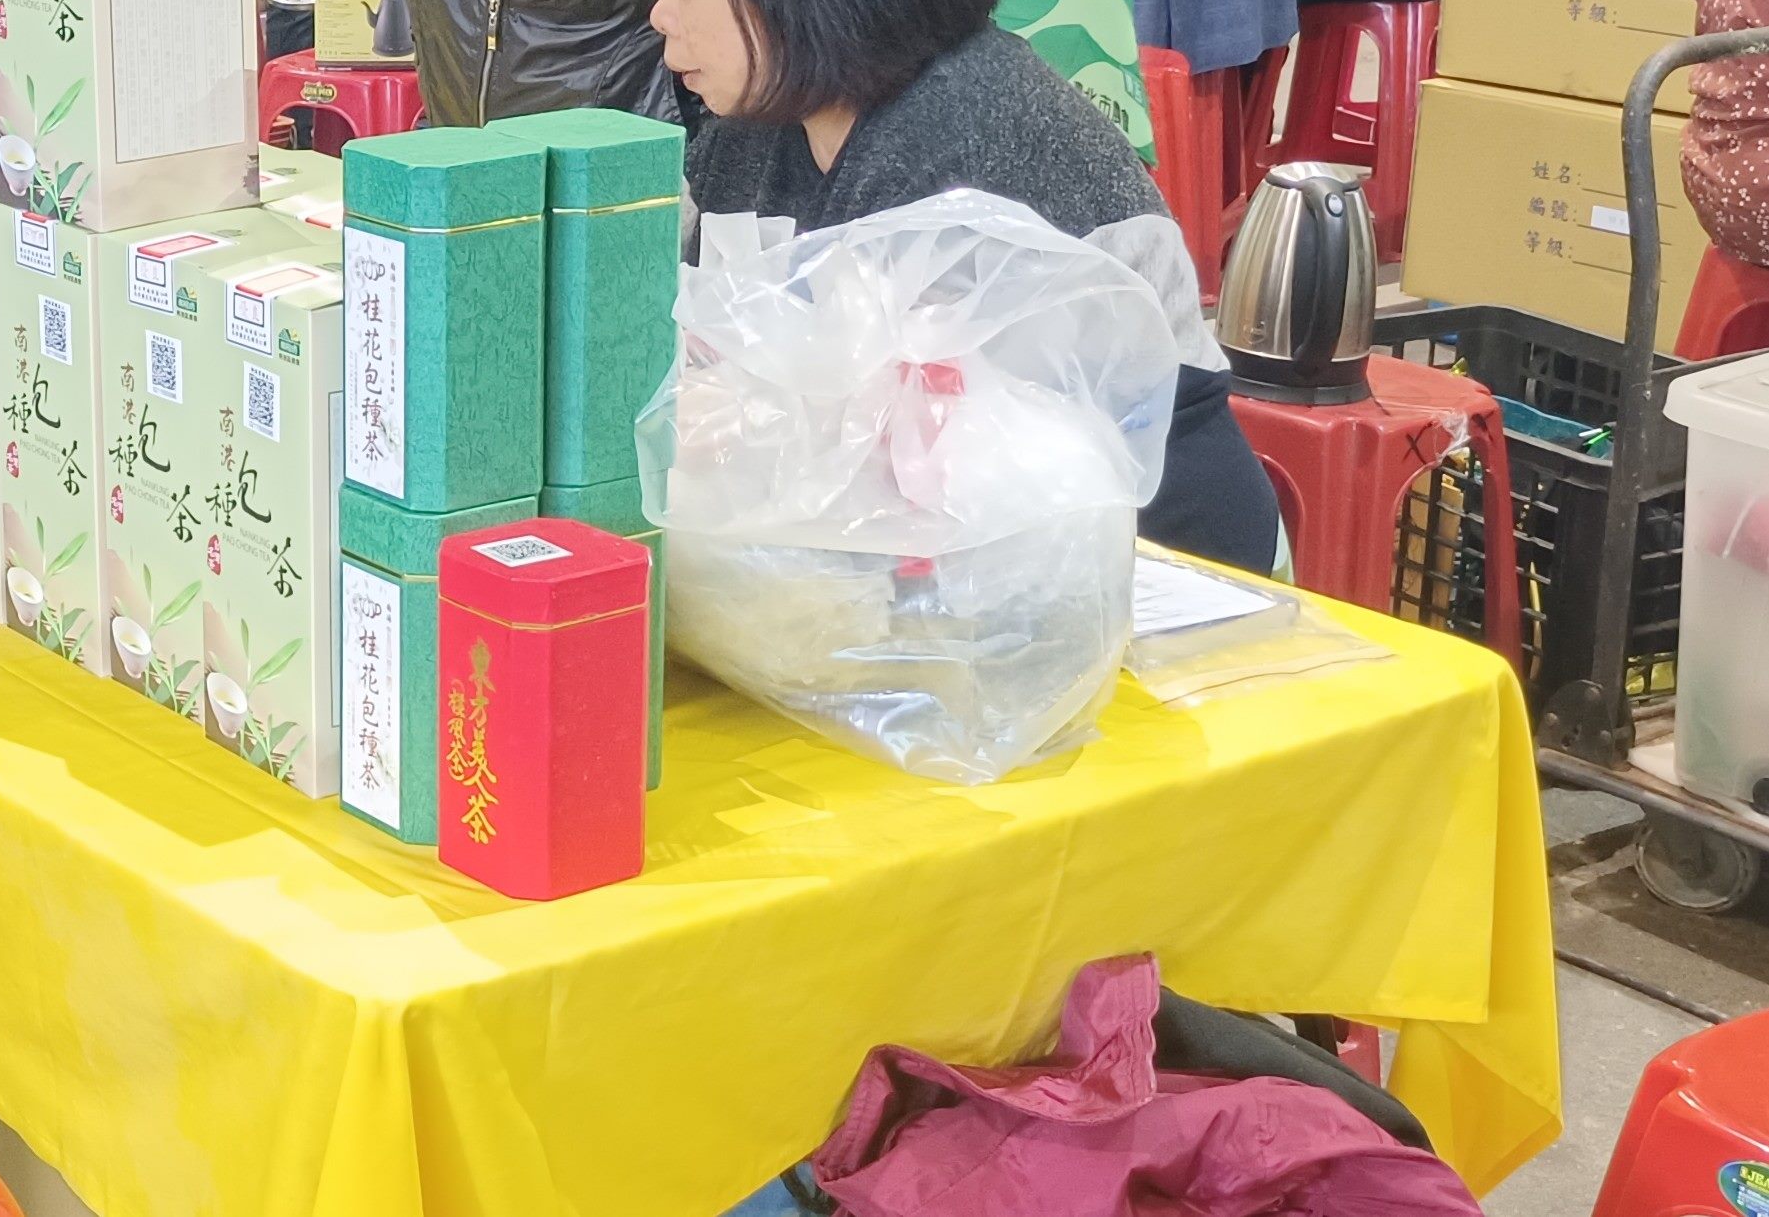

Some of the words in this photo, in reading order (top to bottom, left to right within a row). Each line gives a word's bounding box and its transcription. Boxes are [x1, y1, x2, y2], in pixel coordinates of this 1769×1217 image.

[14, 324, 28, 384] 南港
[361, 293, 383, 461] 桂花包種茶
[120, 362, 136, 425] 南港
[219, 407, 235, 472] 南港
[359, 629, 381, 789] 桂花包種茶
